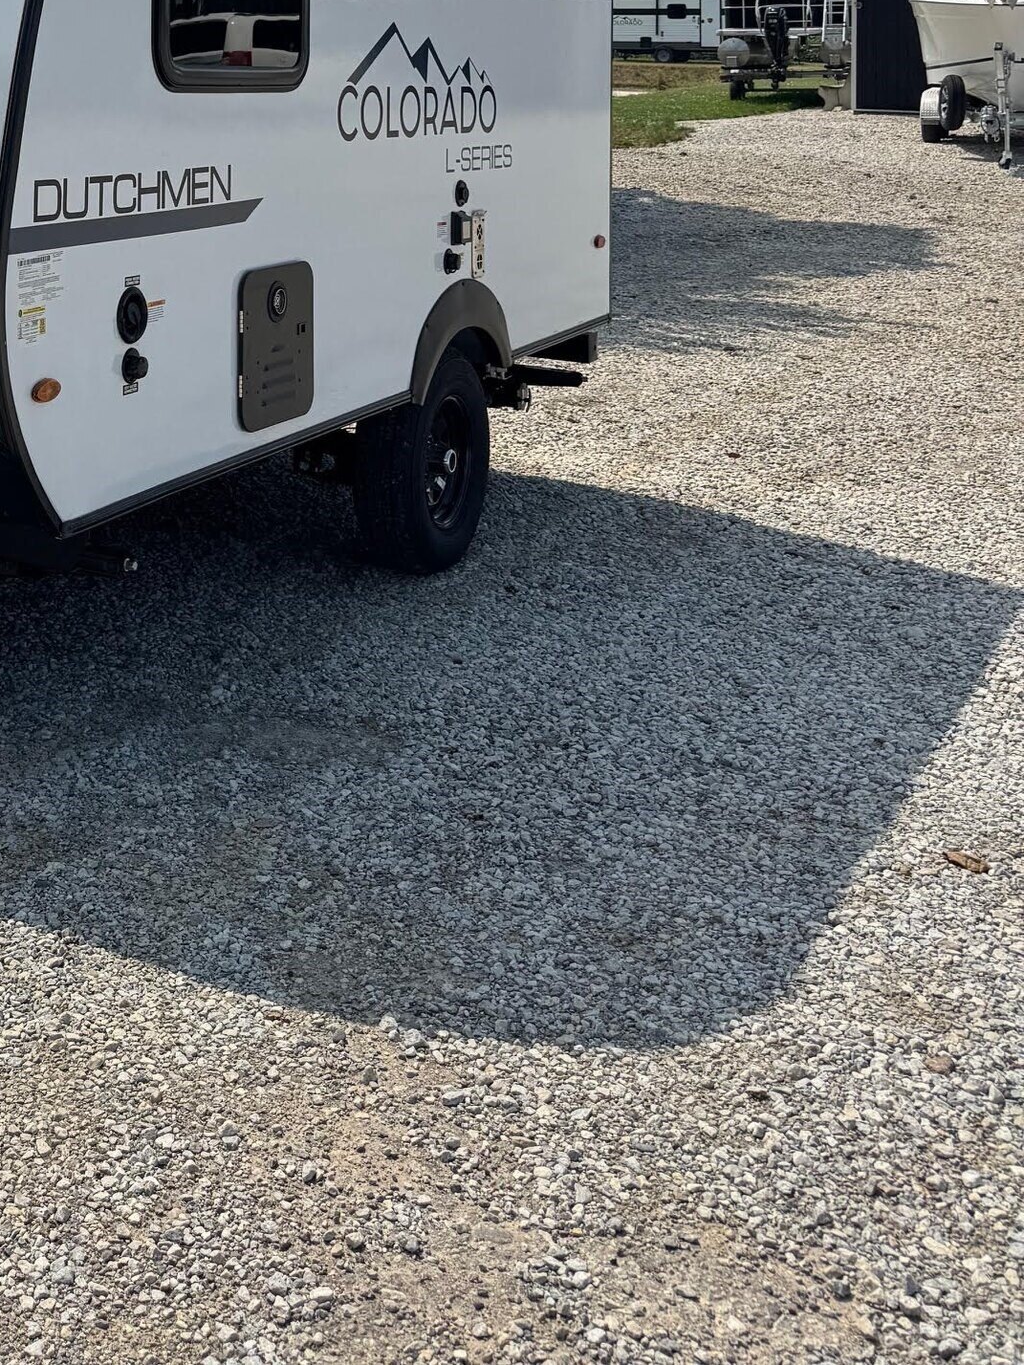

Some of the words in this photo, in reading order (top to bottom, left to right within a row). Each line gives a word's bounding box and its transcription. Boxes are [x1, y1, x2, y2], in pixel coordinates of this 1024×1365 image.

[337, 85, 497, 142] COLORADO
[445, 144, 513, 173] L-SERIES
[33, 164, 232, 223] DUTCHMEN
